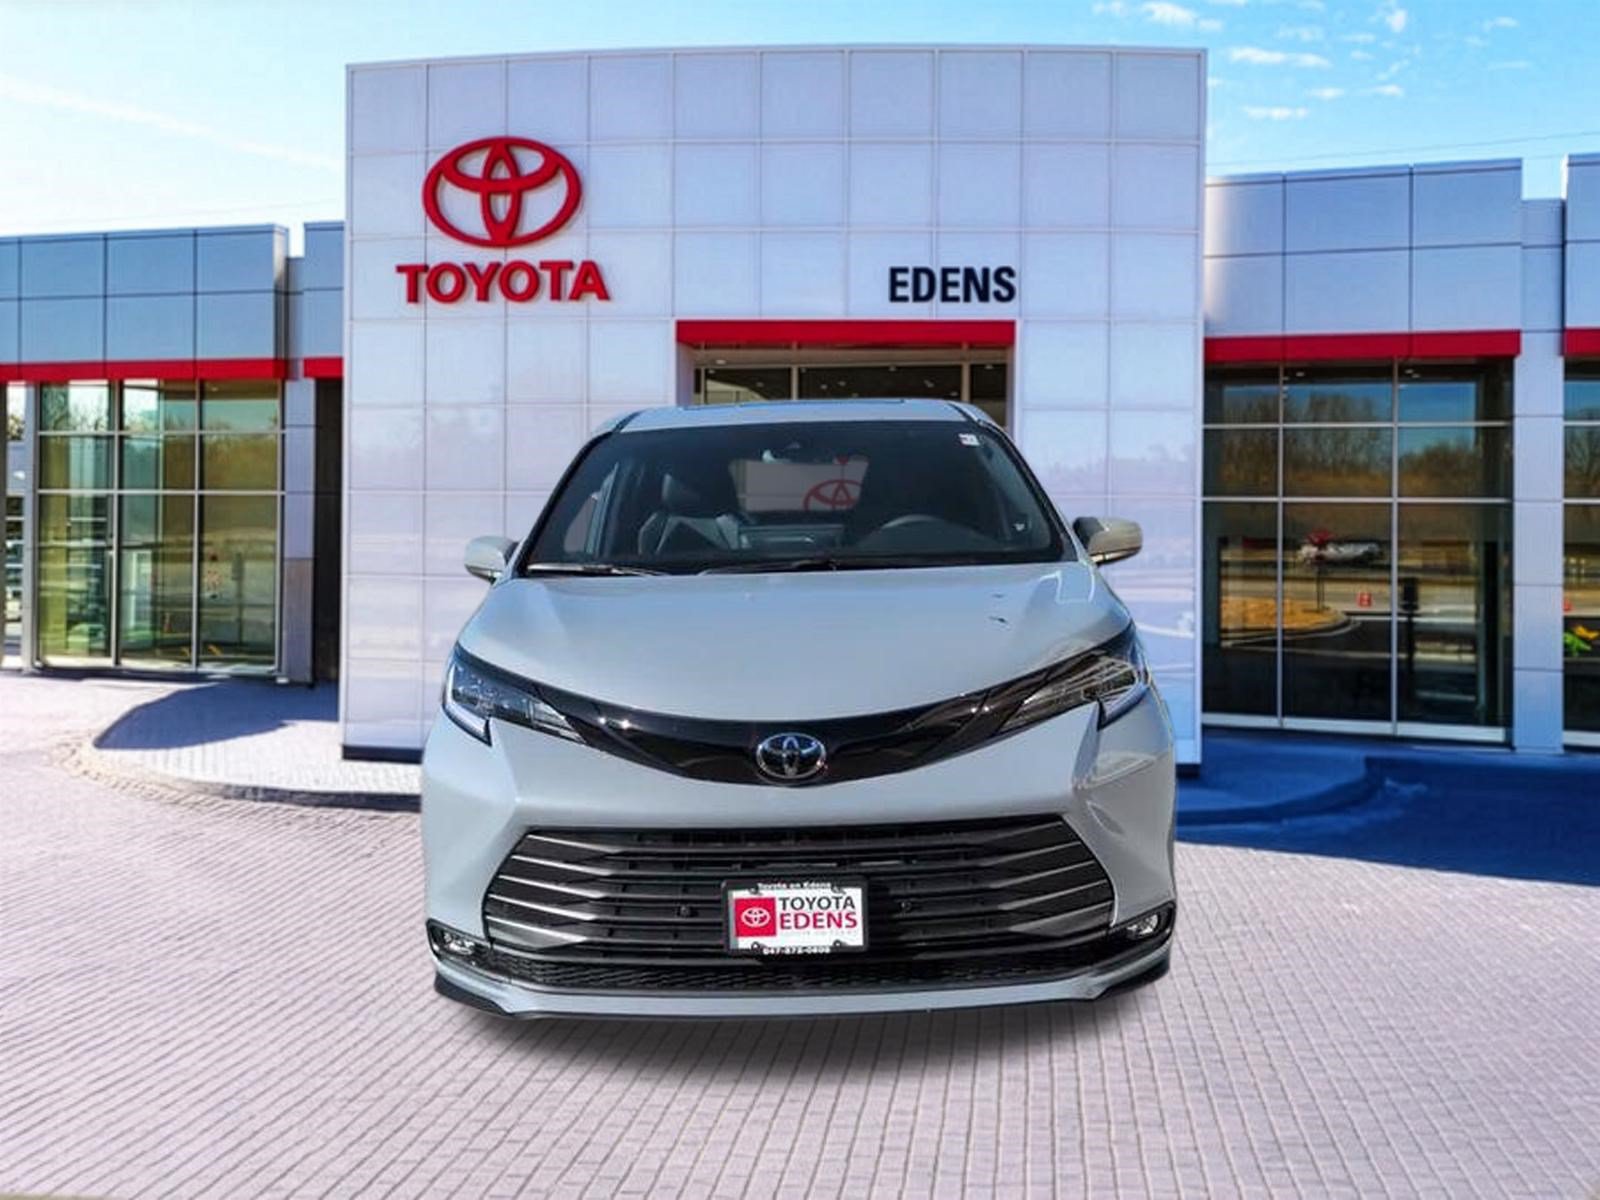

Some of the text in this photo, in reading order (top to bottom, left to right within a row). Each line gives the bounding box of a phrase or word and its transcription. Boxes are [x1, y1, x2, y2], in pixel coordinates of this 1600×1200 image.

[395, 260, 611, 304] TOYOTA
[889, 266, 1017, 303] EDENS
[779, 896, 856, 911] TOYOTA
[780, 912, 857, 929] EDENS
